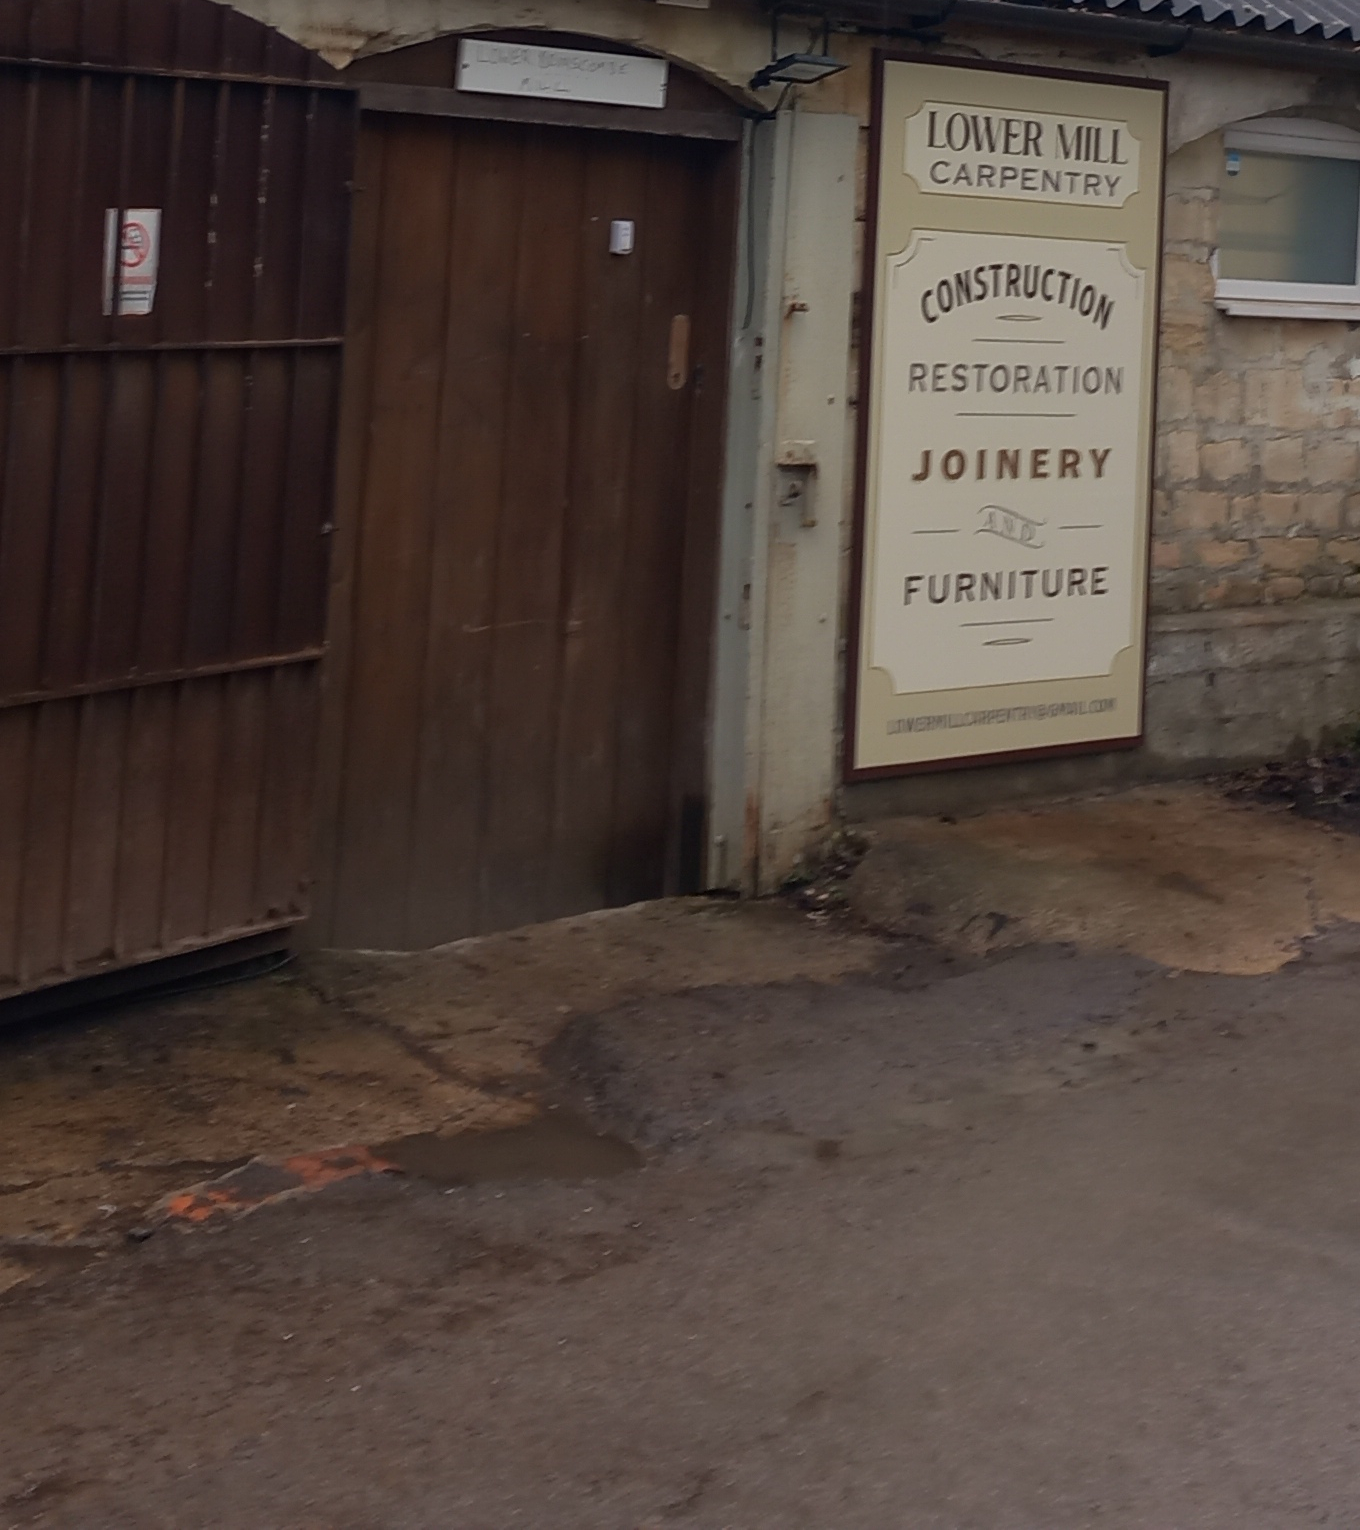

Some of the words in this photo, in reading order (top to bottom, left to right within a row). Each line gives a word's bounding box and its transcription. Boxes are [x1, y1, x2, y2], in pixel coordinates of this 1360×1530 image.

[927, 110, 1044, 158] LOWER
[1056, 123, 1128, 165] MILL
[929, 160, 1122, 197] CARPENTRY
[920, 263, 1115, 331] CONSTRUCTION
[908, 362, 1124, 395] RESTORATION
[911, 448, 1113, 482] JOINERY
[981, 511, 1037, 541] AND
[903, 566, 1110, 606] FURNITURE
